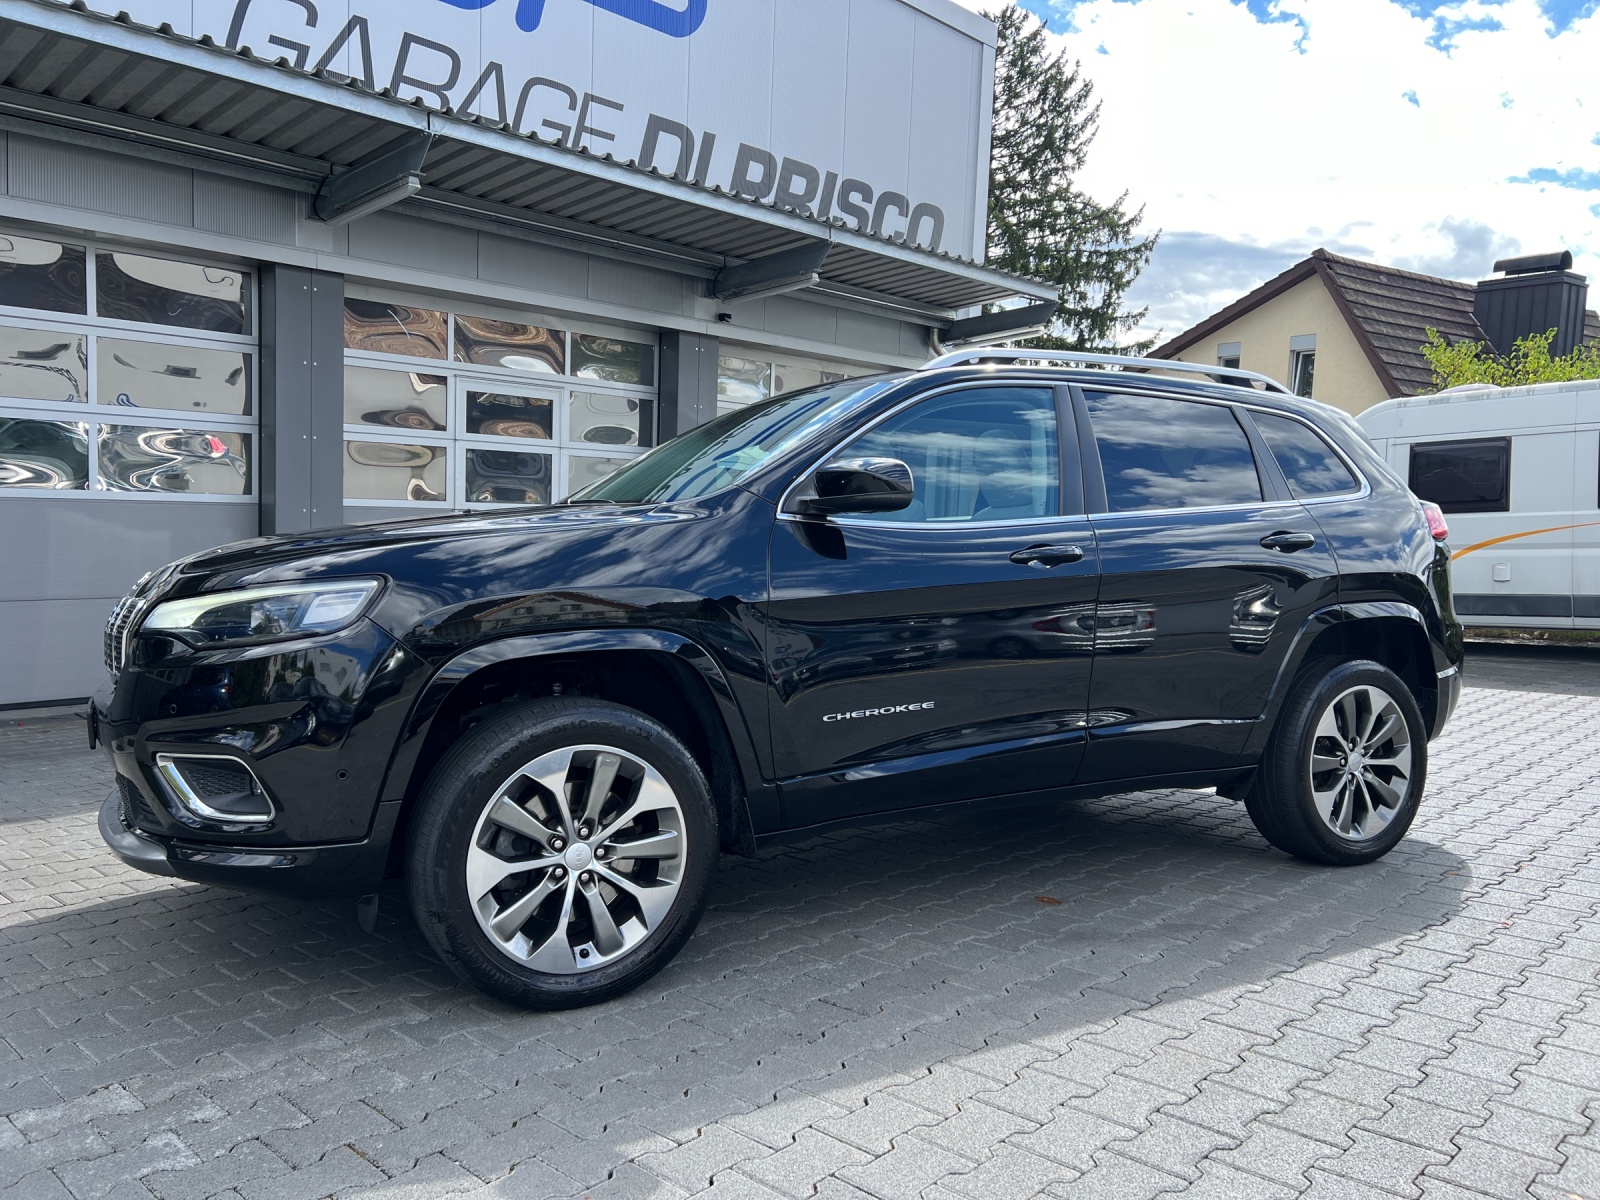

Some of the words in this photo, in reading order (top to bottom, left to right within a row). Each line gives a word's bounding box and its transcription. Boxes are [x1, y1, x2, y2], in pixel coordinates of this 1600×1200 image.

[225, 0, 624, 148] GARAGE
[637, 112, 717, 187] DI
[728, 142, 945, 251] PRISCO
[822, 701, 935, 722] CHEROKEE
